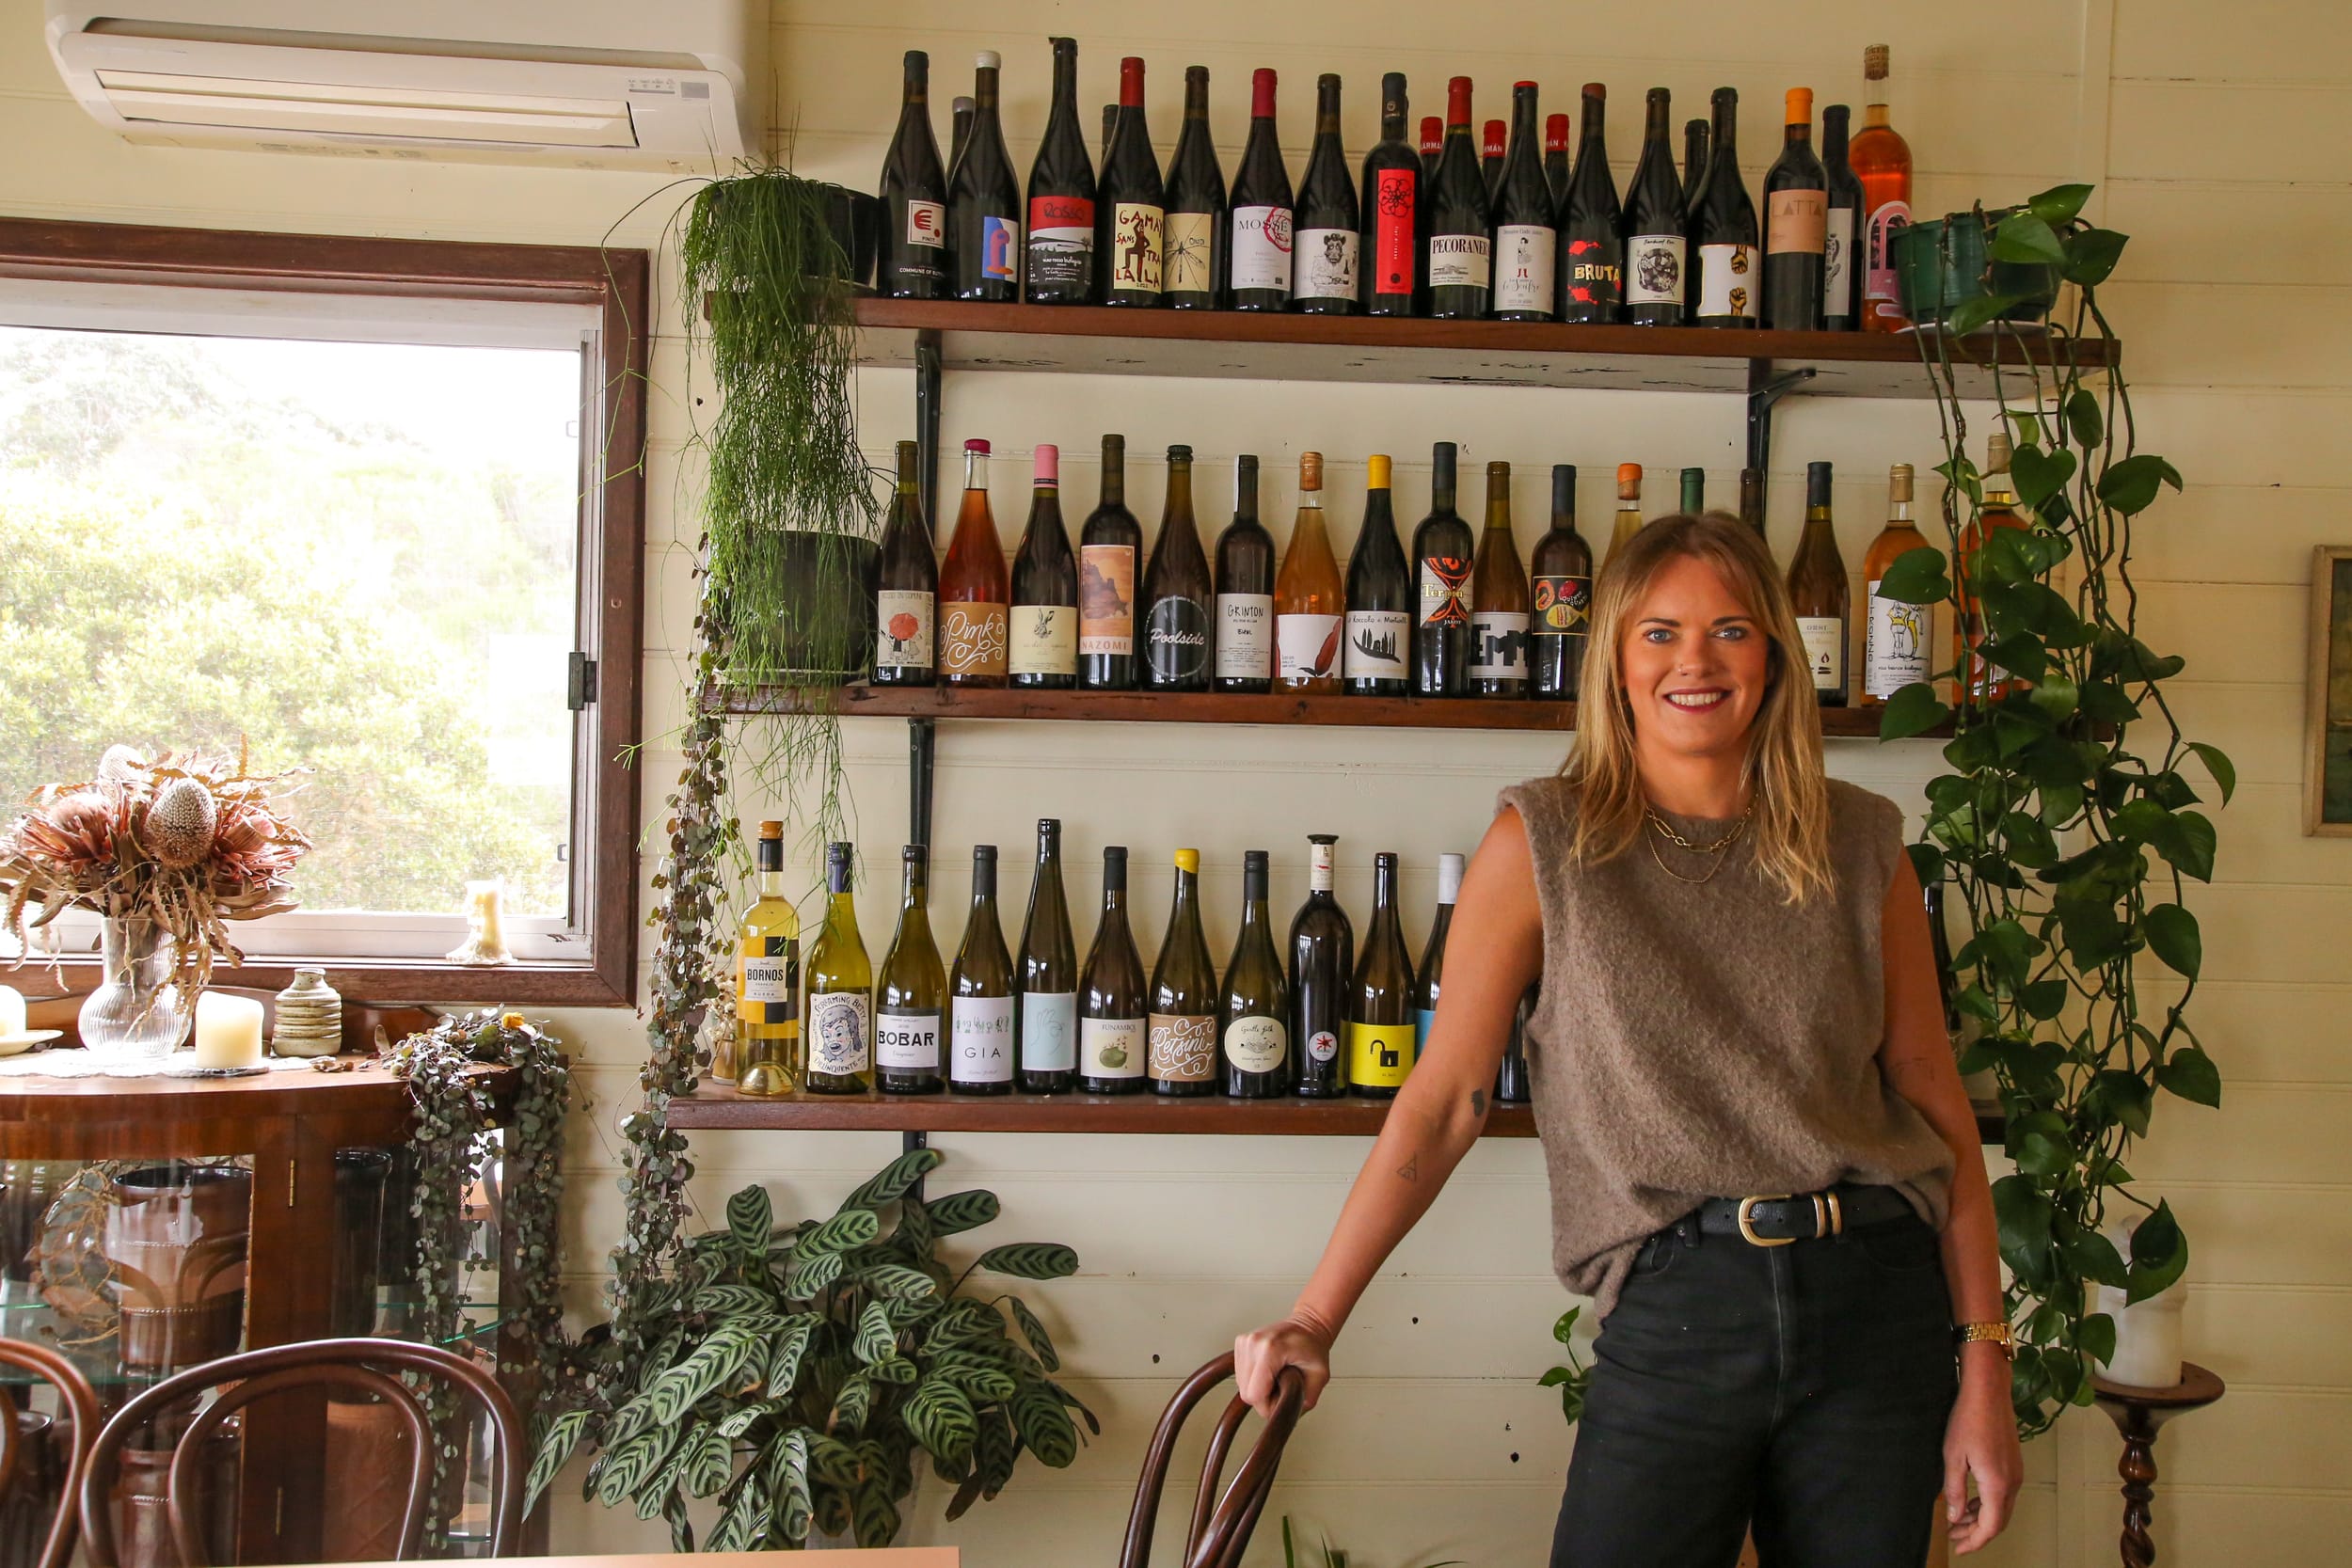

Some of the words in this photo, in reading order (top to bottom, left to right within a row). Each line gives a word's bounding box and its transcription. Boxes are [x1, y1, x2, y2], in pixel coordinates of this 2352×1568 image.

[1772, 199, 1822, 216] LATTA
[1119, 210, 1163, 238] GAMAY
[1238, 219, 1288, 232] MOSSE
[1116, 232, 1135, 245] SANS
[1146, 249, 1161, 264] TRA
[1115, 267, 1136, 282] LA
[1144, 268, 1160, 288] LA
[1422, 583, 1463, 601] Terpin
[1227, 604, 1264, 617] GRINTON
[1150, 627, 1204, 645] Poolside
[1082, 641, 1127, 652] NAZOMI
[747, 969, 784, 981] BORNOS
[815, 996, 850, 1016] SCREAMING
[878, 1030, 934, 1046] BOBAR
[964, 1046, 1001, 1059] GIA
[814, 1056, 858, 1072] DELINQUENTE
